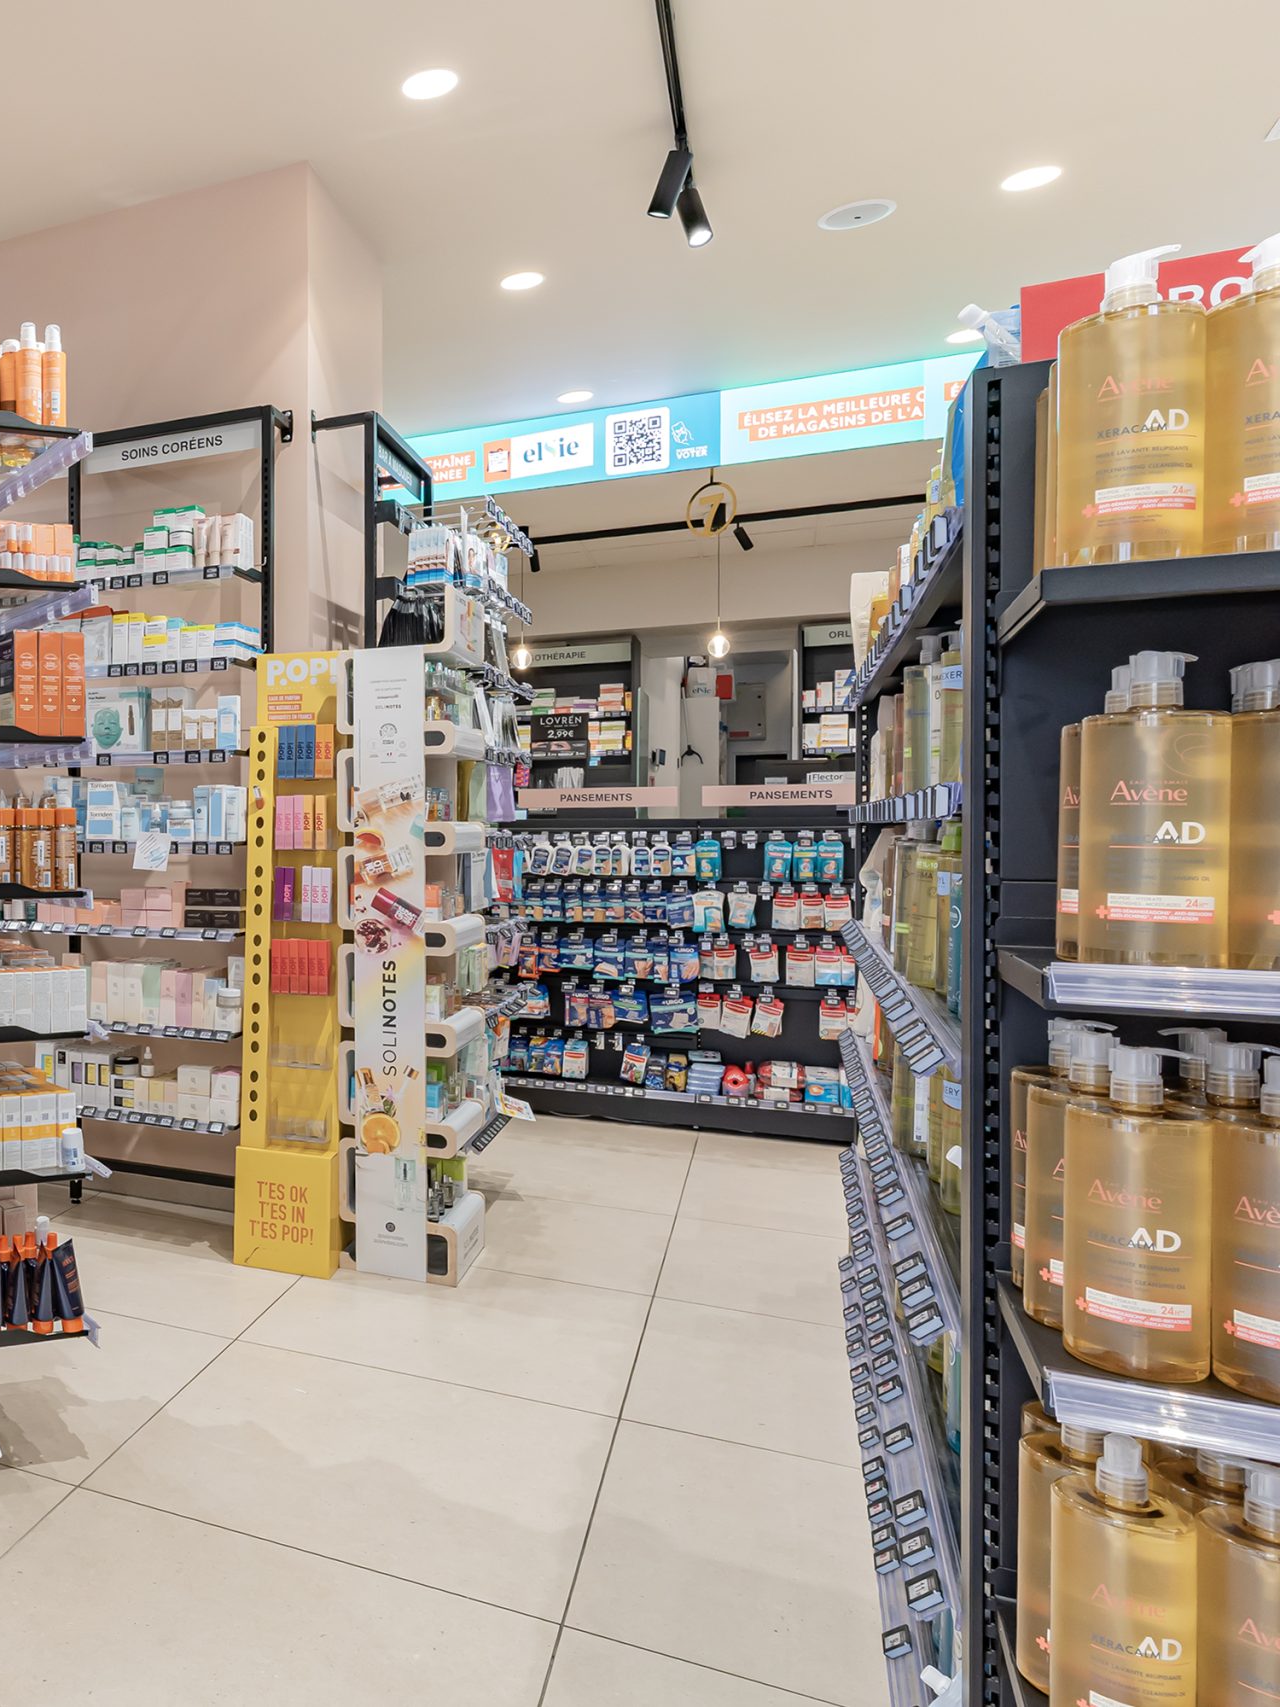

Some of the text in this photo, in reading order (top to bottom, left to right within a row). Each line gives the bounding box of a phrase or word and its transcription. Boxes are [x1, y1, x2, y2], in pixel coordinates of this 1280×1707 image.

[743, 409, 794, 427] ÉLISEZ
[797, 407, 817, 419] LA
[822, 392, 911, 415] MEILLEURE
[1141, 408, 1190, 433] AD
[1245, 410, 1280, 425] XERA
[757, 425, 778, 438] DE
[782, 414, 866, 435] MAGASINS
[871, 410, 893, 423] DE
[1096, 422, 1168, 440] XERACALM
[121, 434, 224, 462] SOINS CORÉENS
[432, 466, 463, 481] NNÉE
[828, 629, 851, 639] ORL
[812, 772, 844, 782] Flector
[559, 793, 633, 803] PANSEMENTS
[749, 789, 833, 801] PANSEMENTS
[1110, 780, 1188, 801] Avène
[1152, 820, 1206, 845] AD
[382, 959, 397, 1077] SOLINOTES
[257, 1180, 308, 1204] T'ES OK
[1087, 1178, 1163, 1210] Avène
[258, 1201, 306, 1224] T'ES IN
[1234, 1195, 1280, 1224] Avè
[249, 1219, 314, 1246] T'ES POP!
[1128, 1227, 1182, 1253] AD
[1090, 1631, 1161, 1660] XERACALM
[1135, 1636, 1183, 1661] AD
